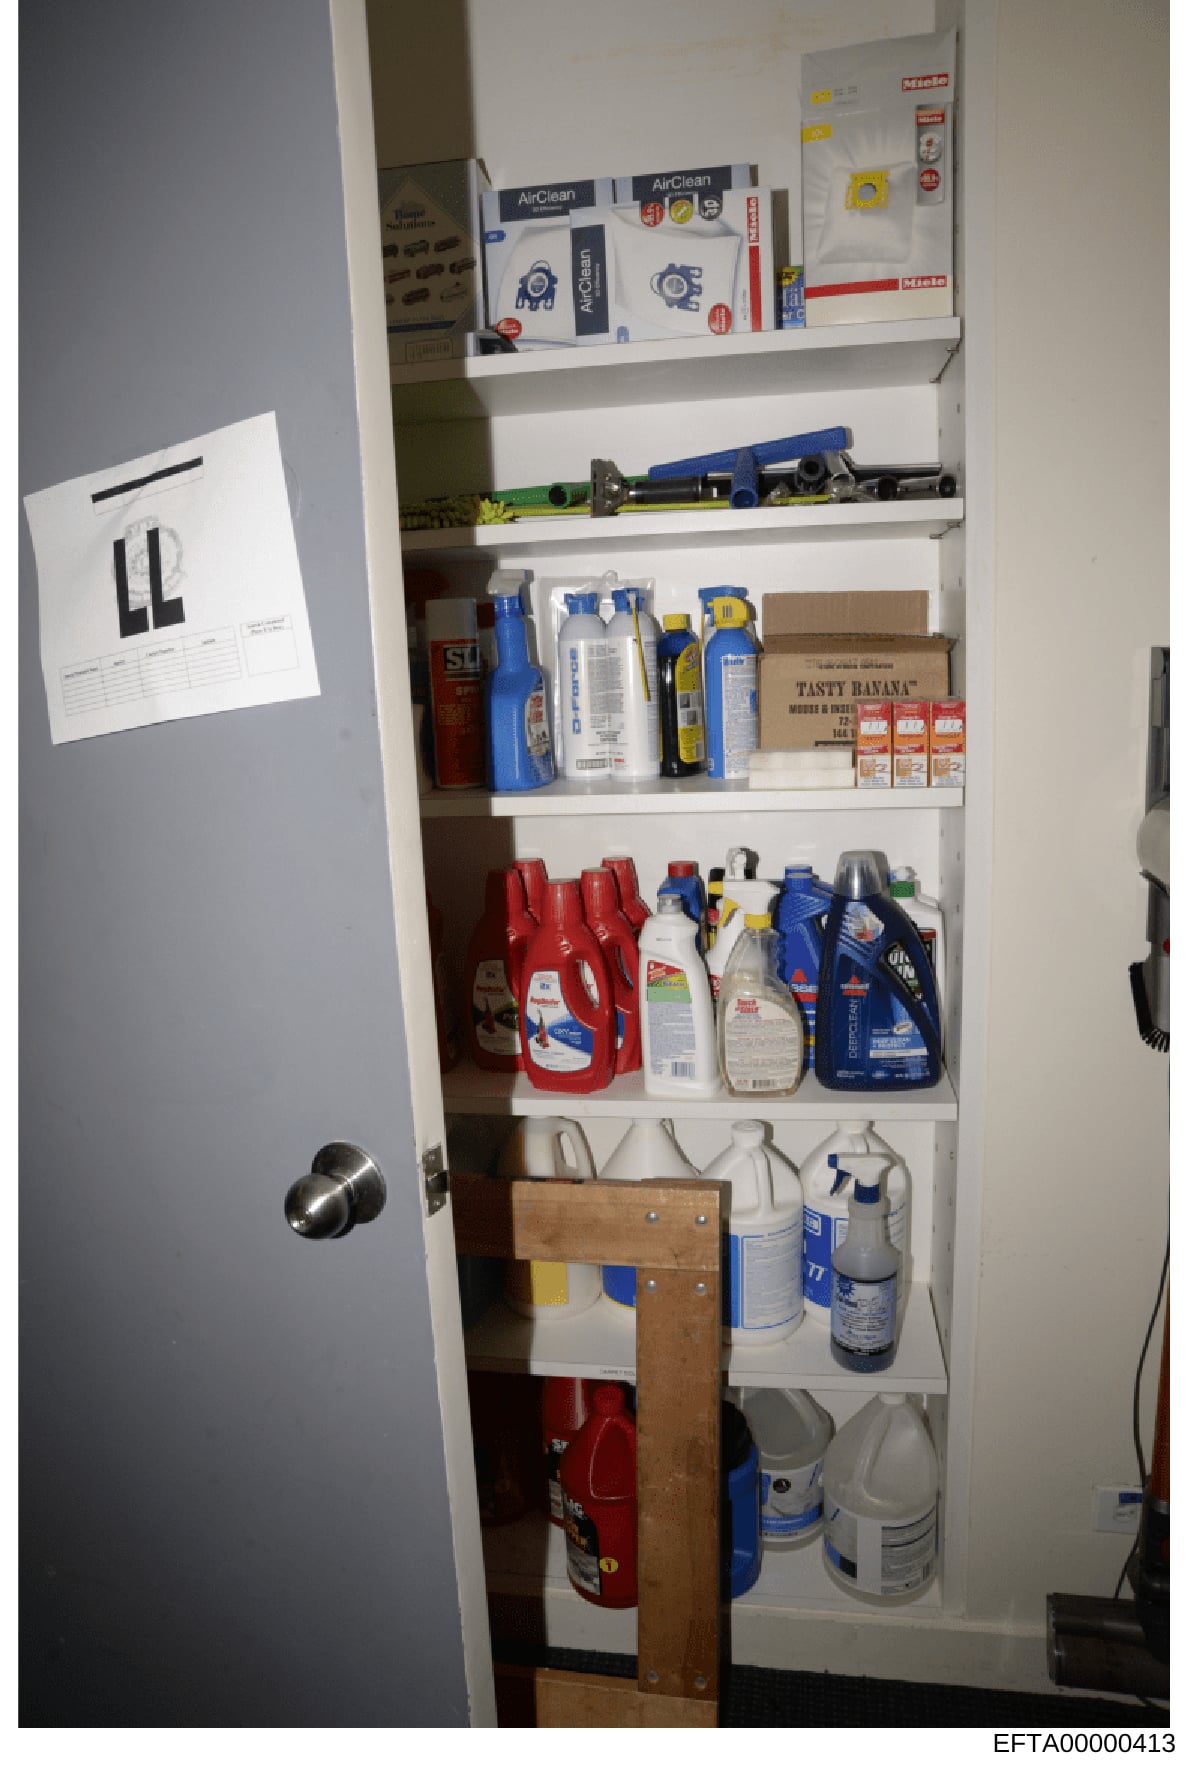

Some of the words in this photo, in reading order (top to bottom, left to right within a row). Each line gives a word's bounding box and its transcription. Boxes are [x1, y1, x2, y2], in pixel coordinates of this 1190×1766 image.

[904, 74, 949, 90] Miele
[652, 175, 711, 192] AirClean
[518, 190, 576, 205] AirClean
[749, 198, 758, 241] Miele
[578, 249, 594, 313] AirClean
[904, 279, 945, 289] Miele
[113, 527, 186, 639] LL
[796, 681, 846, 697] TASTY
[788, 704, 819, 714] MOUSE
[821, 704, 828, 714] &
